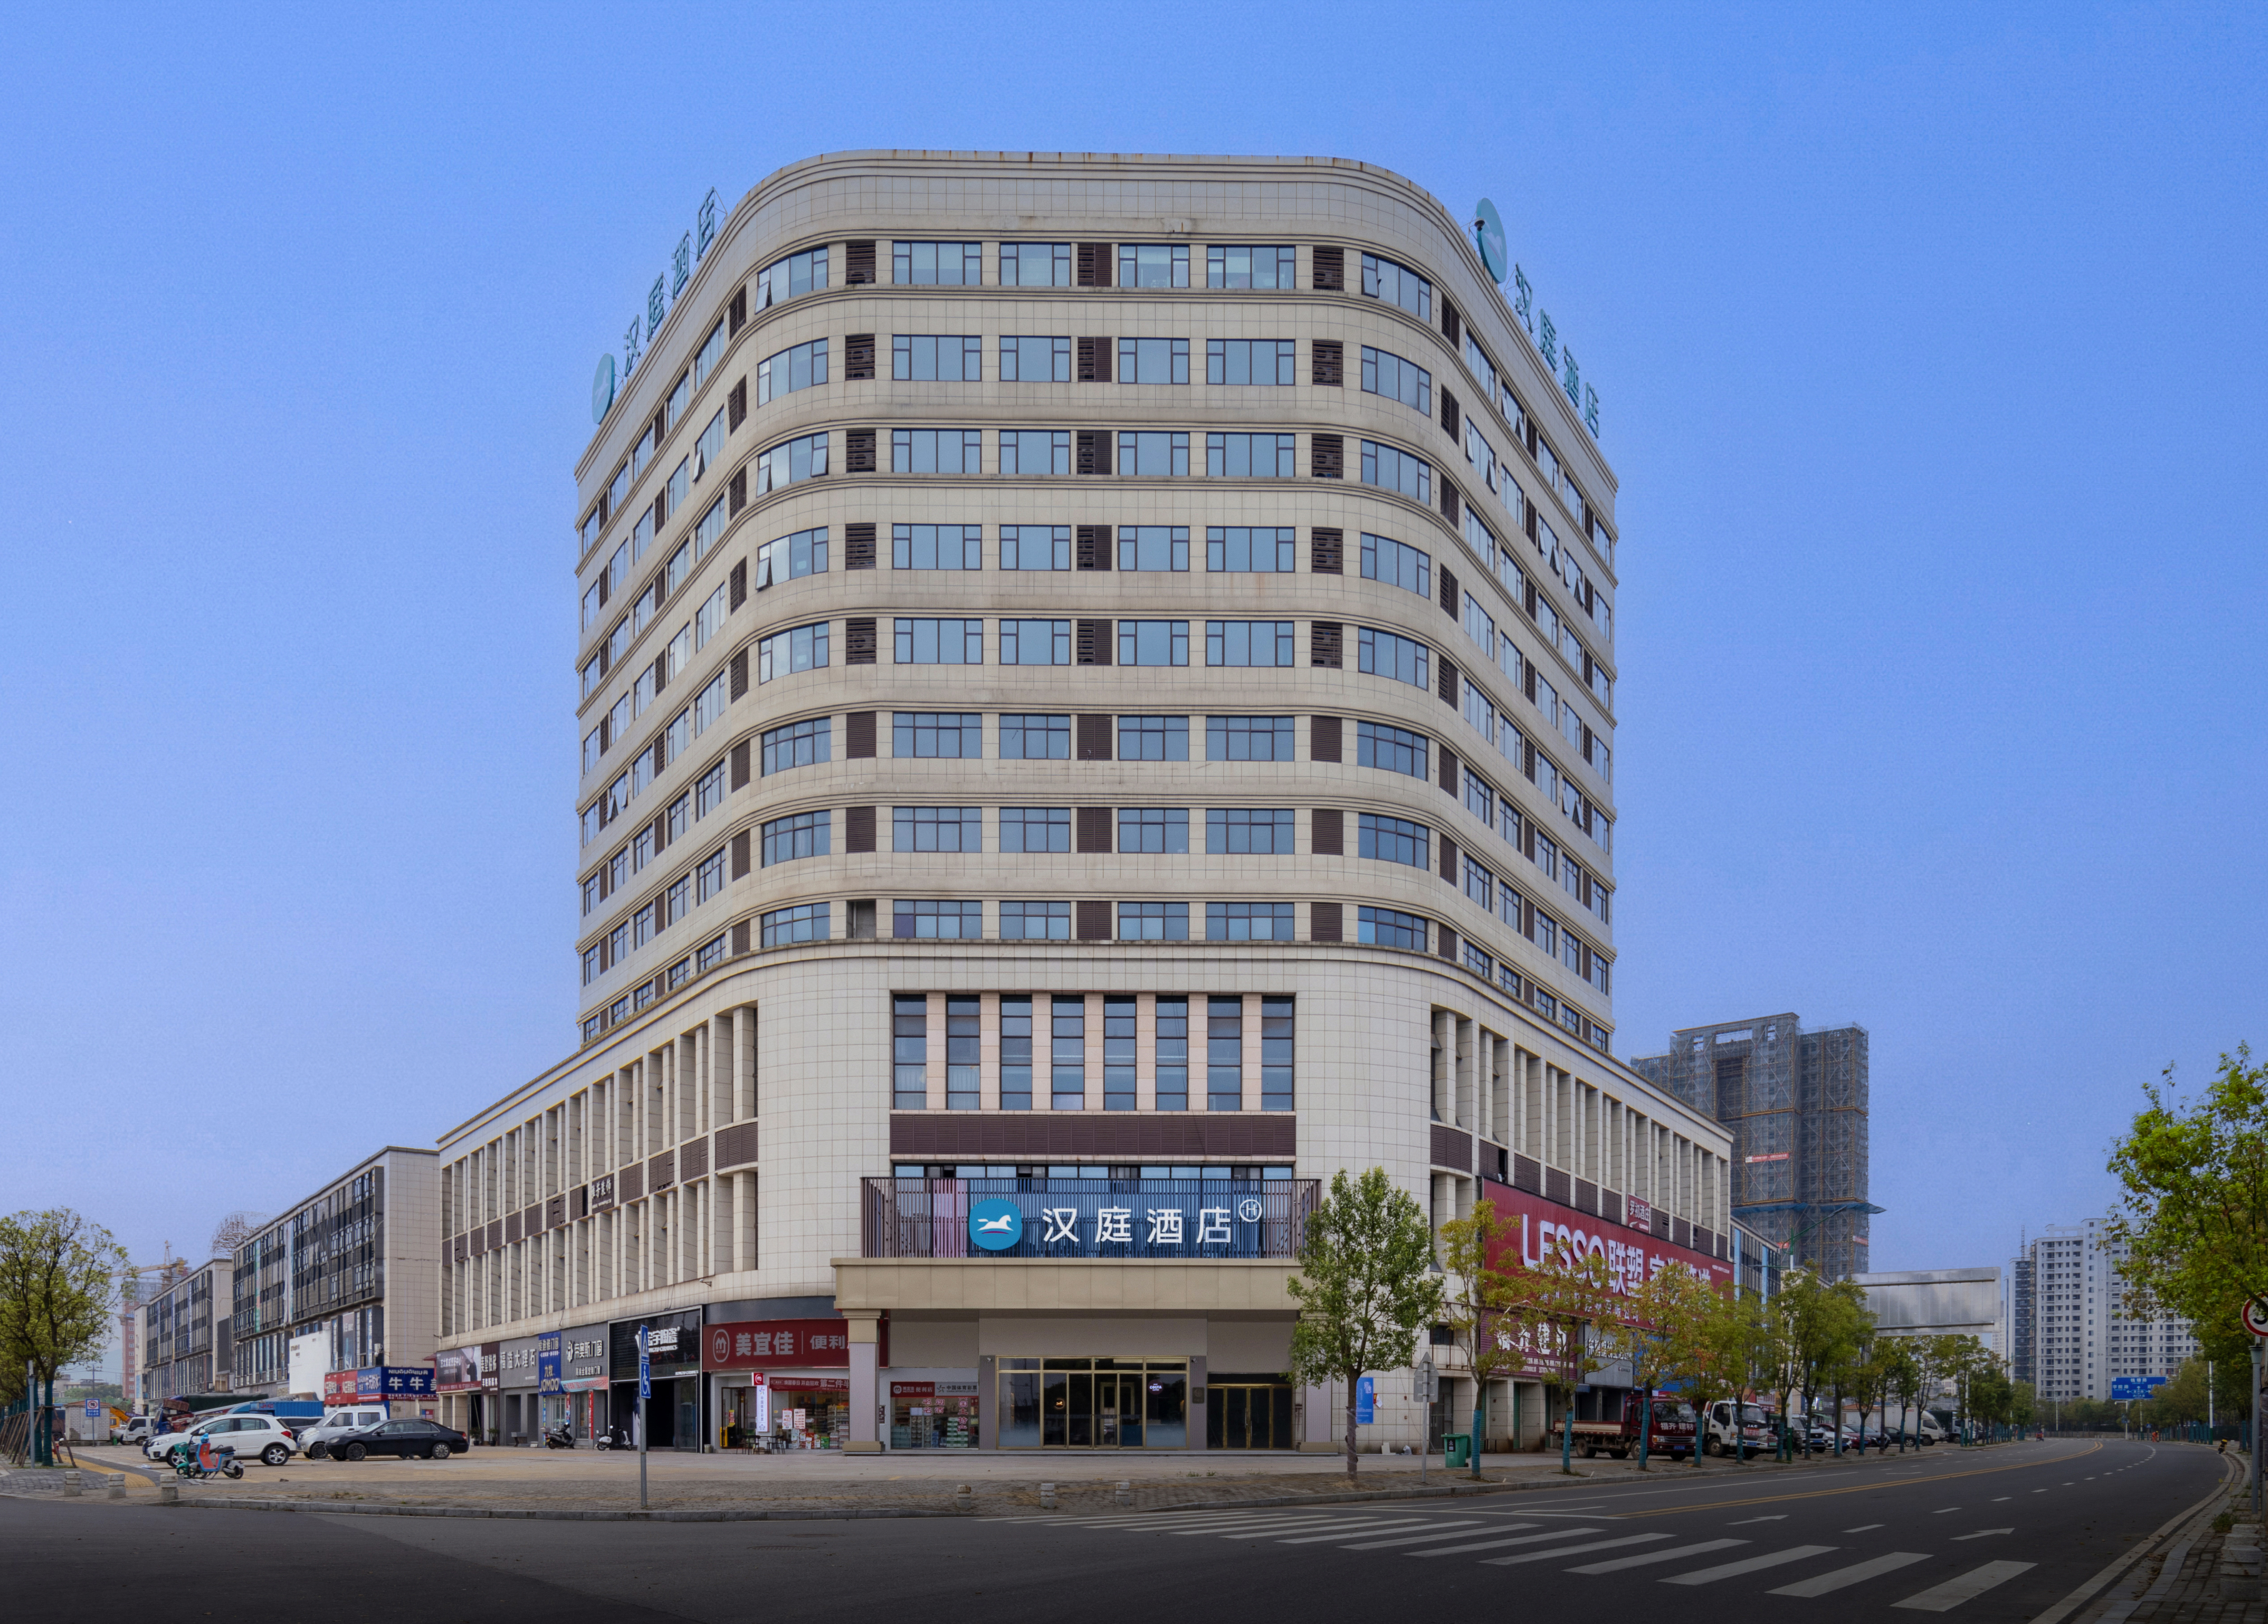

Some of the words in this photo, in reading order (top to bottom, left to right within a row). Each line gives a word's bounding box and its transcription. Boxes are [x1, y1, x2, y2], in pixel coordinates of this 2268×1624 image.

[623, 186, 715, 376] 汉庭酒店
[1515, 262, 1599, 438] 汉庭酒店
[1043, 1206, 1231, 1243] 汉庭酒店
[1523, 1214, 1607, 1289] LESSO
[736, 1331, 794, 1357] 美宜佳
[810, 1335, 849, 1349] 便利
[539, 1378, 560, 1392] JOMOO
[544, 1365, 553, 1377] 九牧
